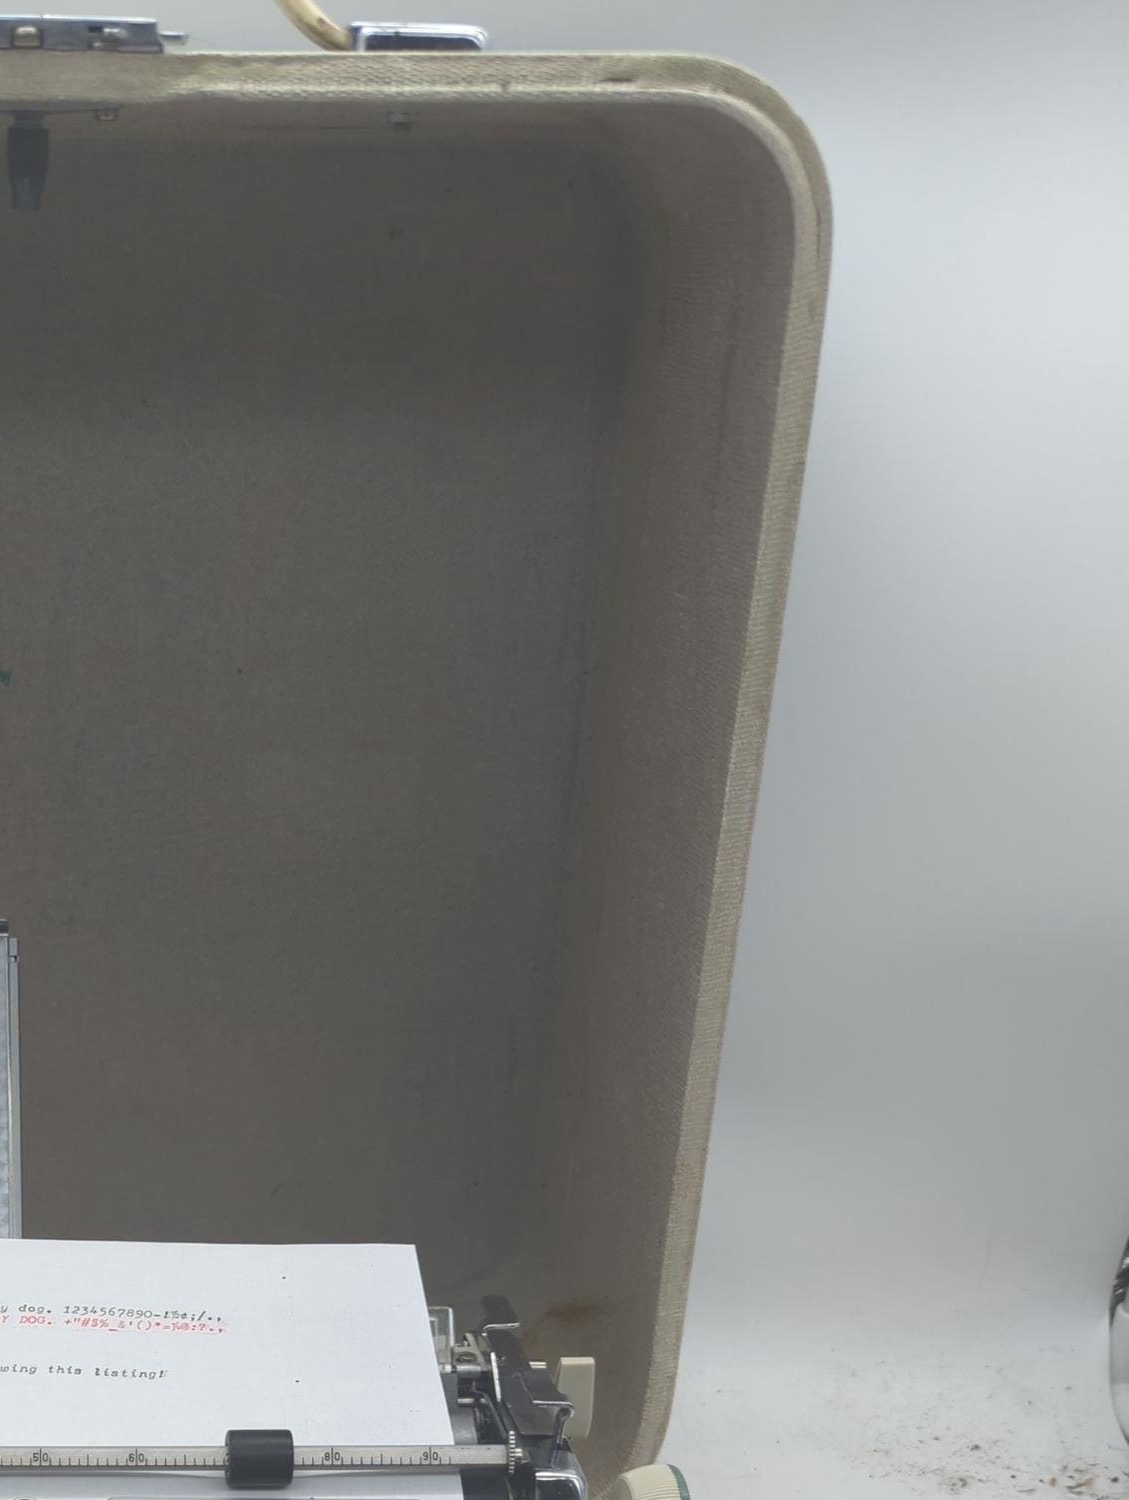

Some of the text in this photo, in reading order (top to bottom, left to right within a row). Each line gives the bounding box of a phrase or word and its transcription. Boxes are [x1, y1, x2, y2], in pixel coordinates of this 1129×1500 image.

[18, 1304, 53, 1315] dog.
[19, 1316, 53, 1326] DOG.
[48, 1365, 82, 1376] this
[94, 1367, 166, 1379] listing!
